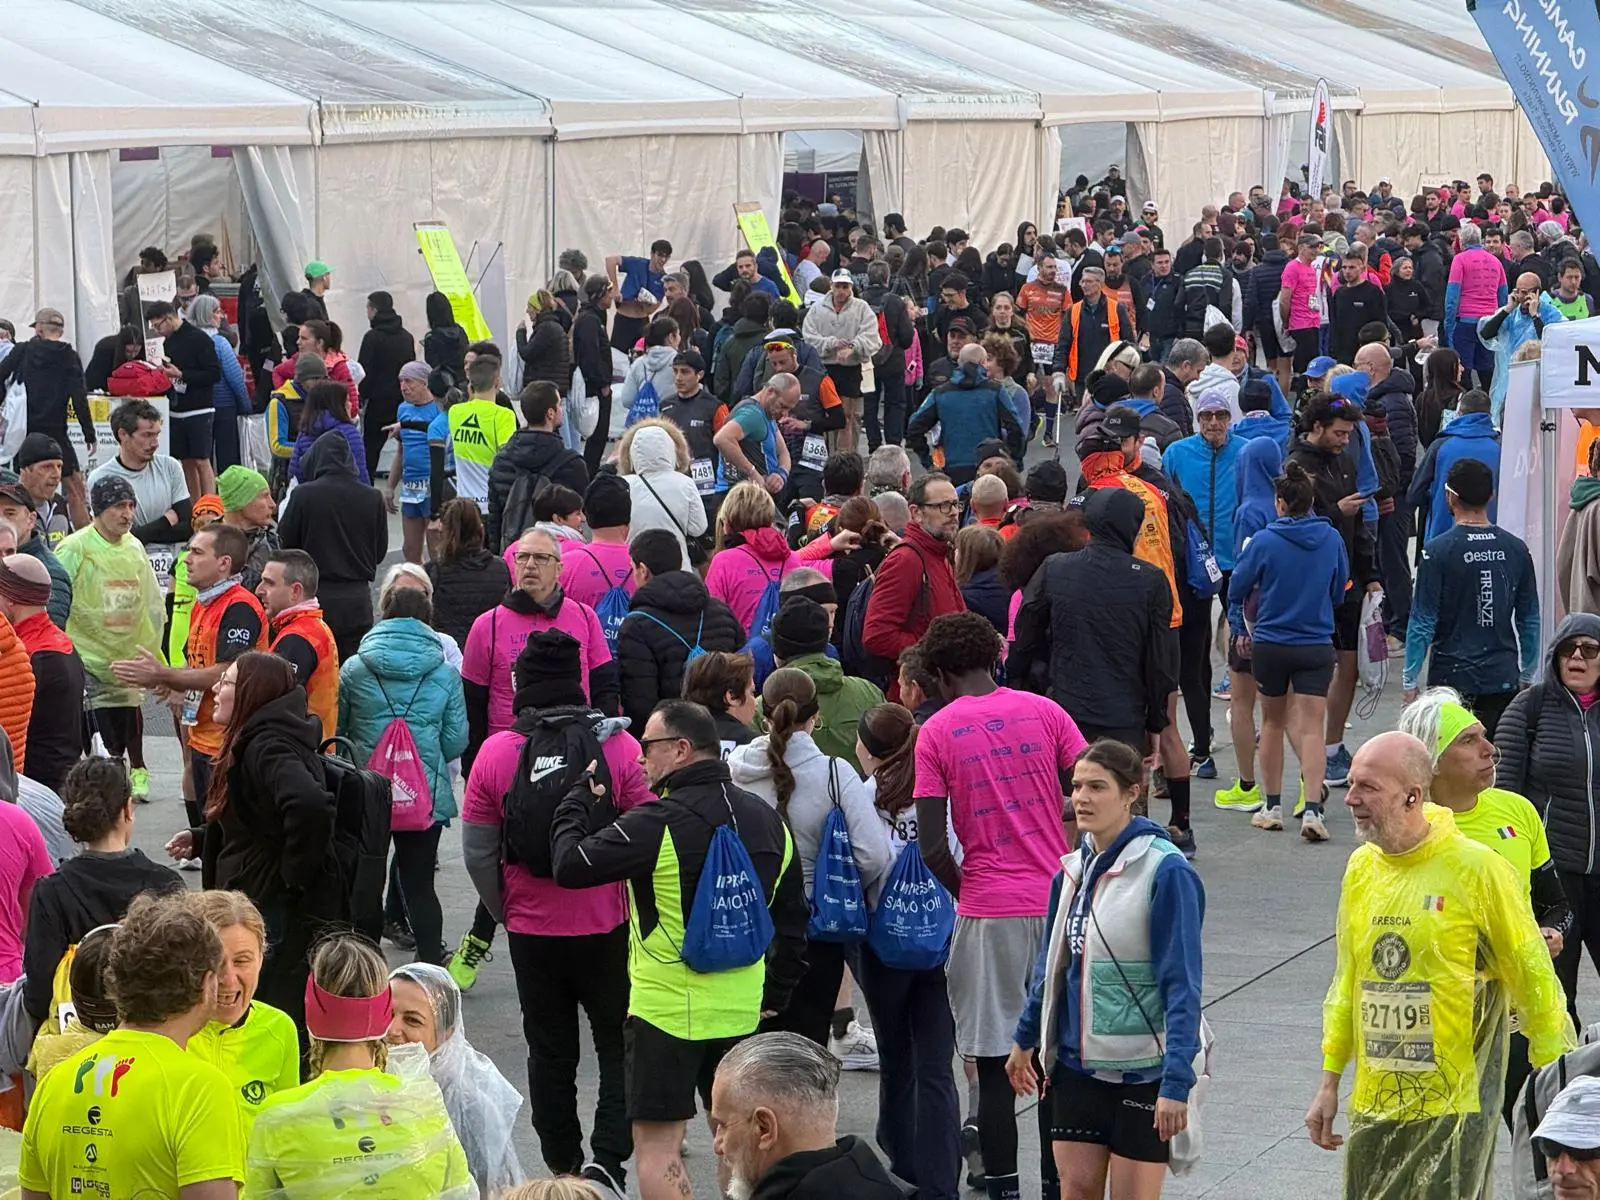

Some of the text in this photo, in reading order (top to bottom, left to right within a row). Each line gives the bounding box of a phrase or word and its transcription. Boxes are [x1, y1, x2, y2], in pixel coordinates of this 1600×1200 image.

[1473, 549, 1506, 561] estra
[1481, 570, 1494, 627] FIRENZE
[227, 628, 250, 640] OXB
[534, 756, 564, 770] NIKE
[1372, 916, 1411, 926] BRESCIA
[1368, 1003, 1418, 1030] 2719
[62, 1125, 113, 1137] REGESTA
